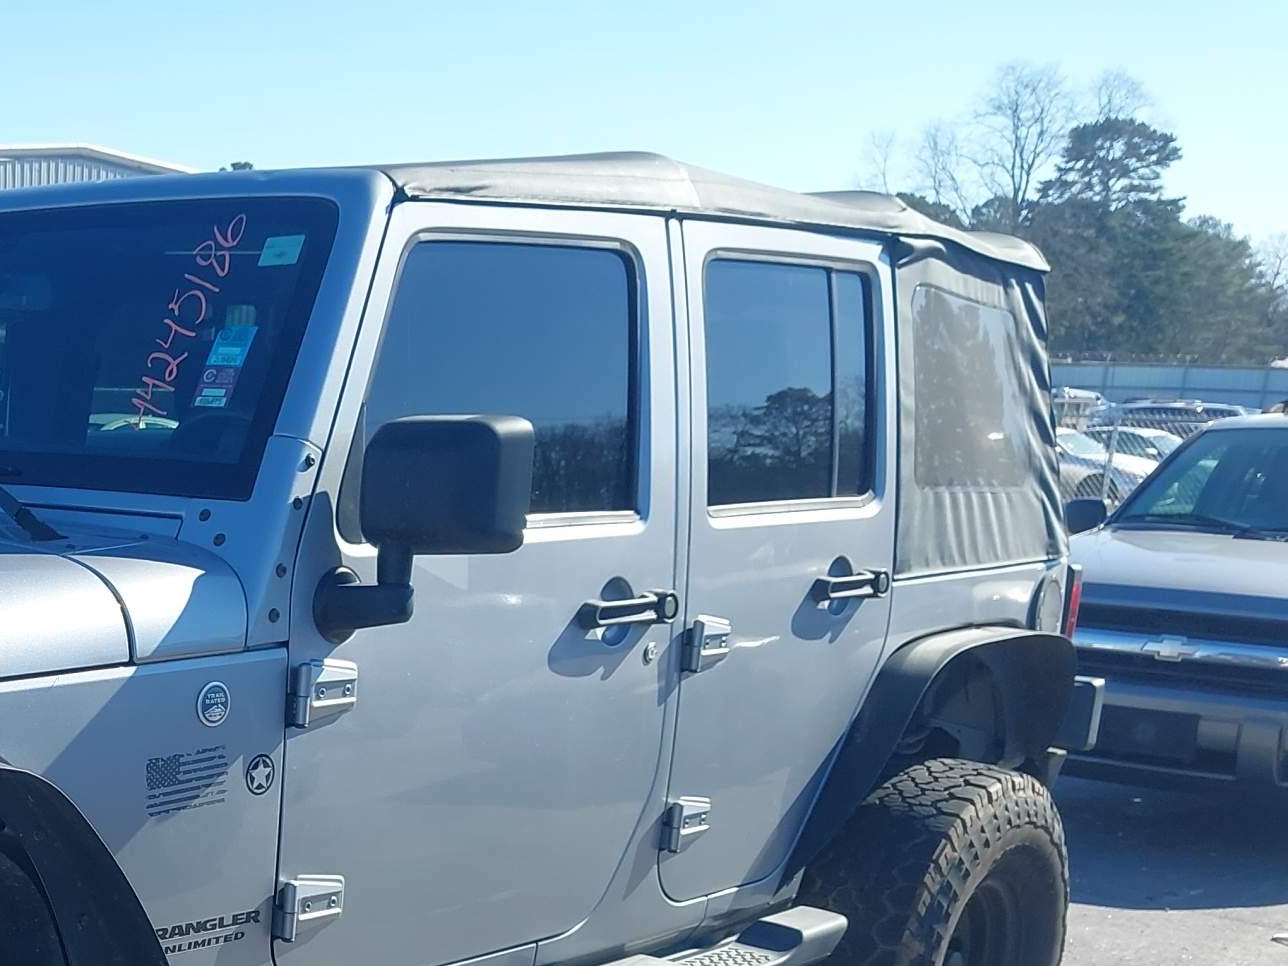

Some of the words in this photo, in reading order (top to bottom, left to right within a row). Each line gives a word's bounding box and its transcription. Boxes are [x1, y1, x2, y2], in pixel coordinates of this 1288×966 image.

[131, 213, 247, 431] 44245186
[205, 697, 226, 705] RATED
[155, 910, 261, 941] RANGLER
[164, 931, 245, 955] NLIMITED
